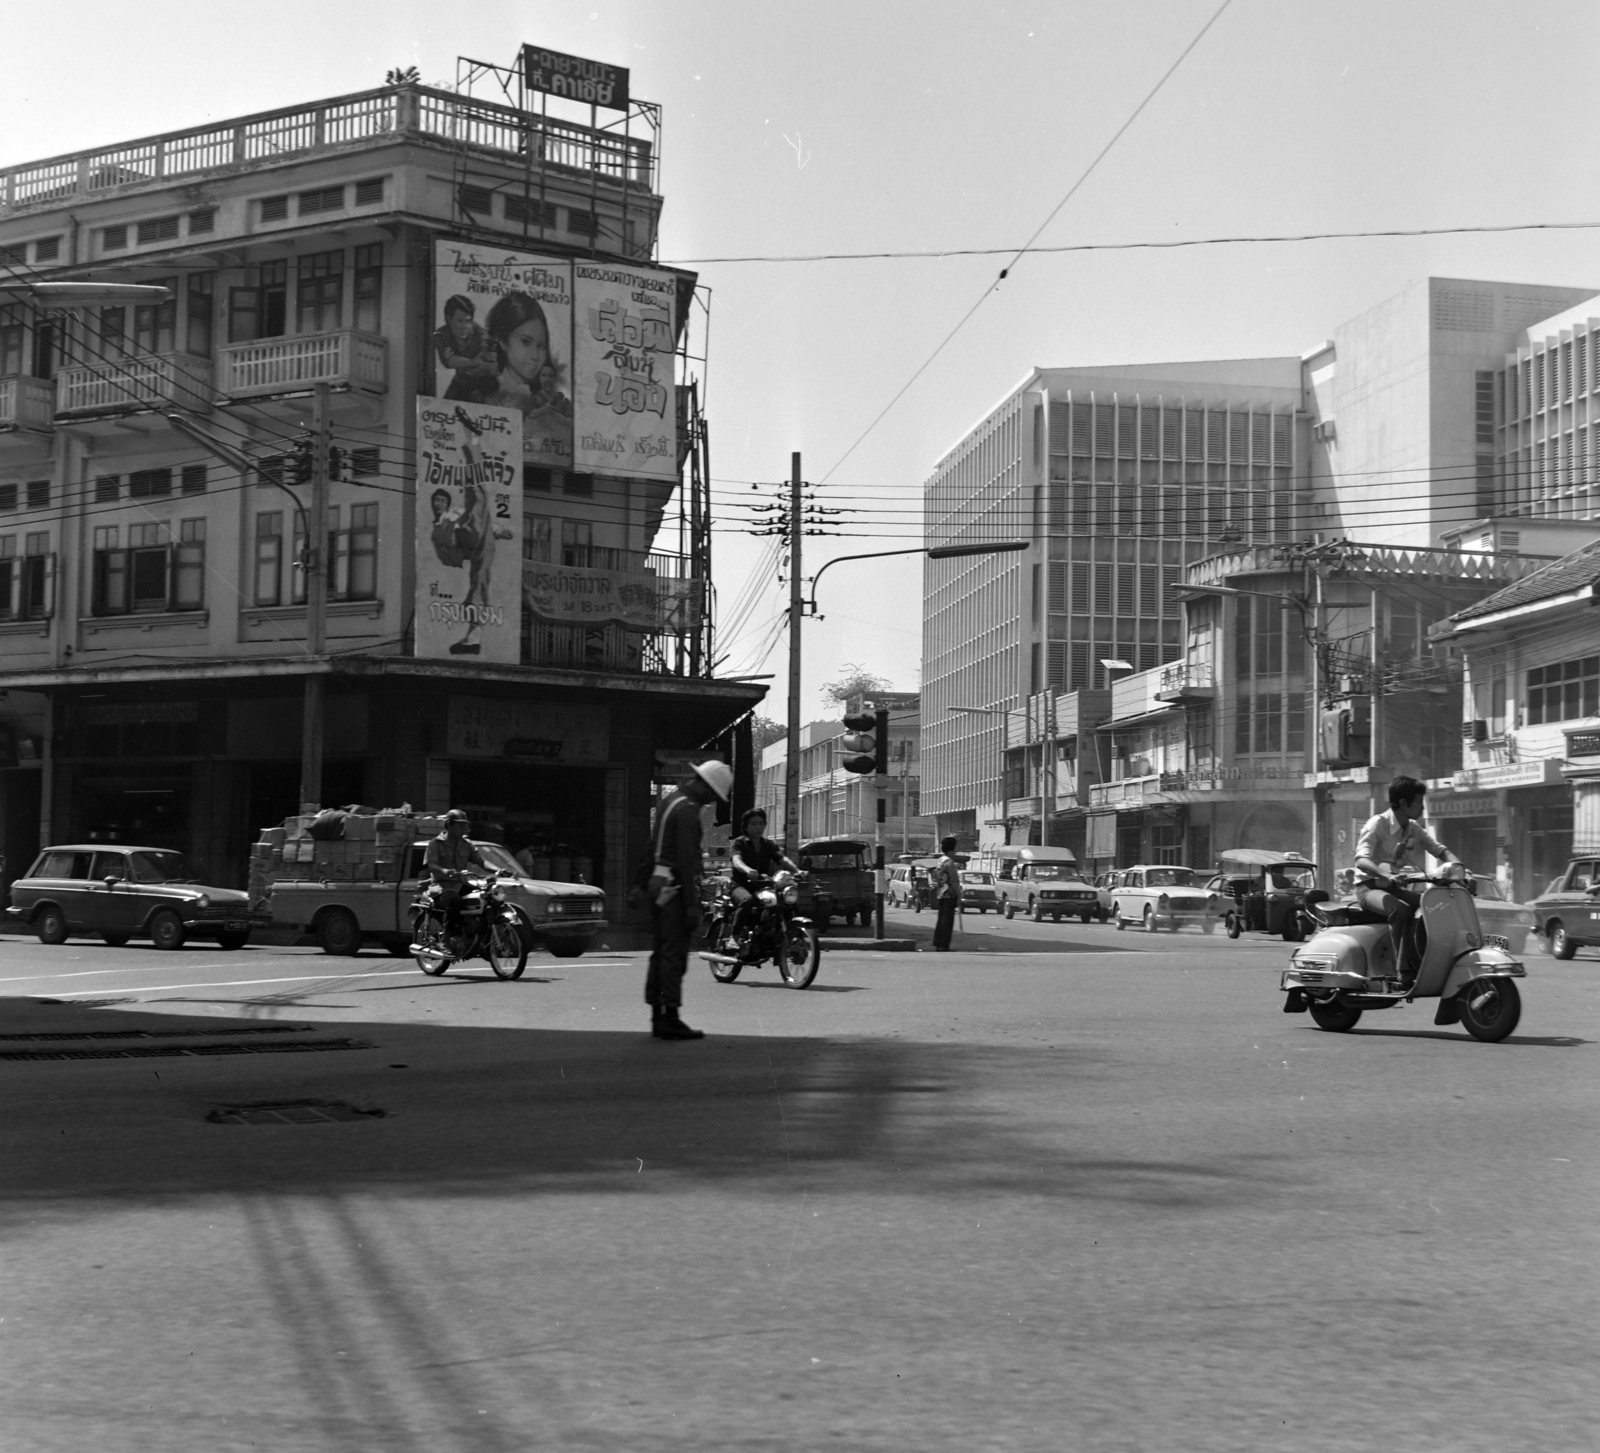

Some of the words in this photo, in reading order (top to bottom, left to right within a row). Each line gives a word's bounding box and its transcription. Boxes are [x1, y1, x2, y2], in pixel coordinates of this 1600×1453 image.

[496, 503, 511, 519] 2
[429, 600, 504, 629] กรุงเกษม
